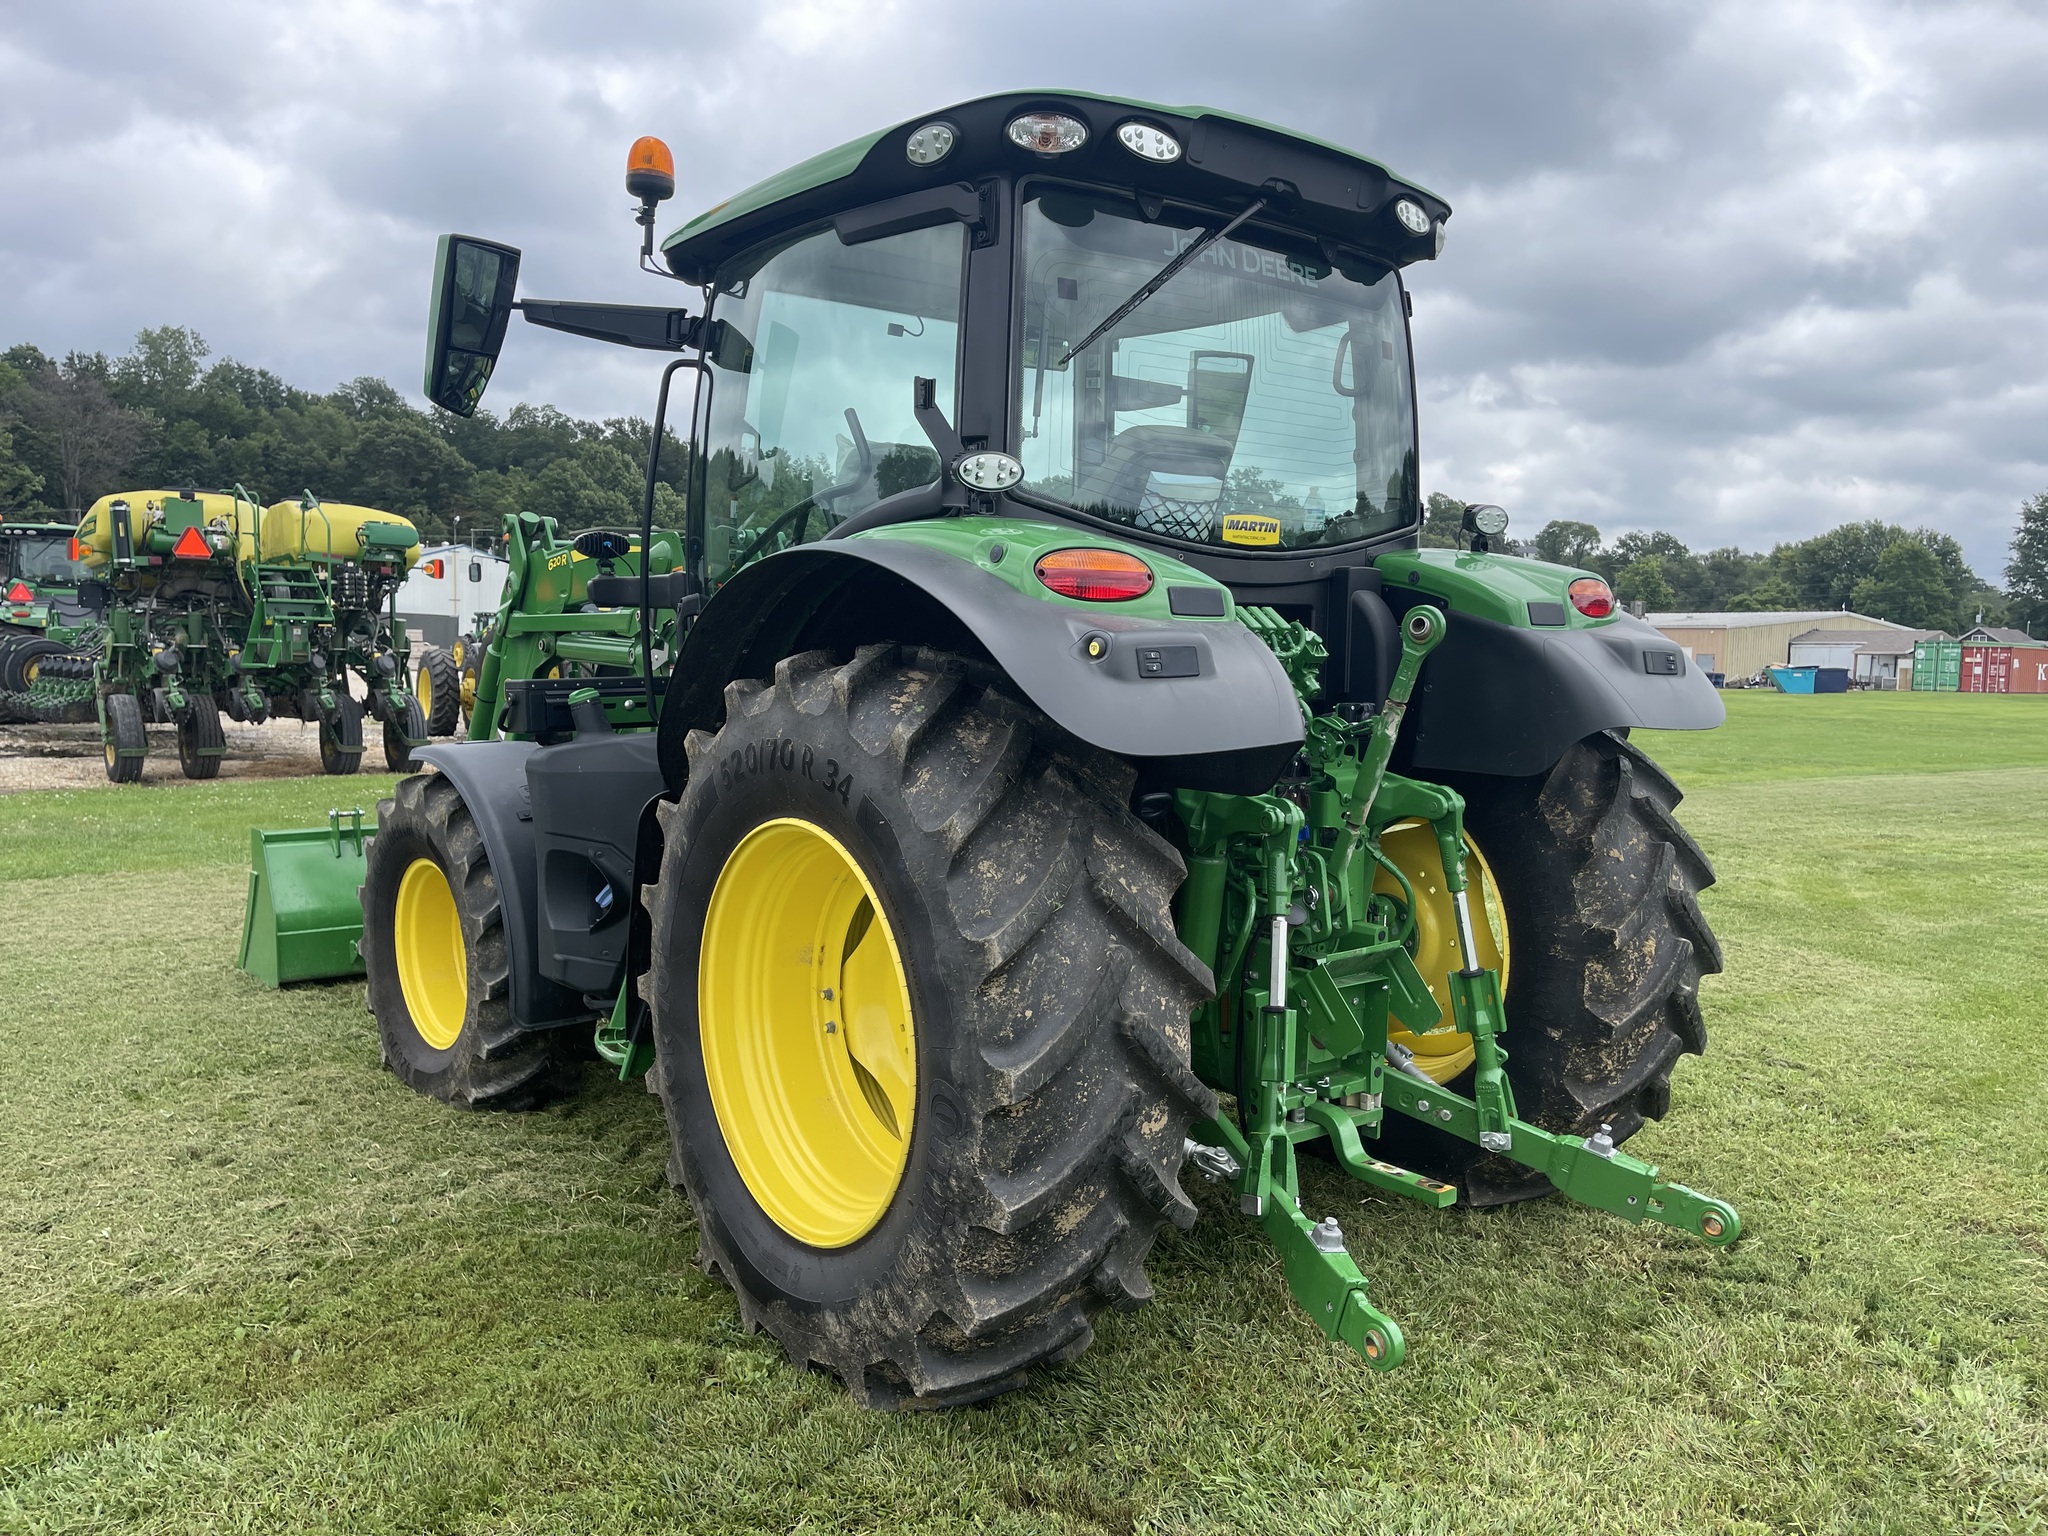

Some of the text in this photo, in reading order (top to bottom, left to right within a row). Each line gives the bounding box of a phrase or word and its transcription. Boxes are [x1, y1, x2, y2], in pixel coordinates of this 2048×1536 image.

[1241, 245, 1319, 288] DEERE
[1226, 519, 1278, 534] MARTIN
[719, 737, 855, 808] 520/70 R 34
